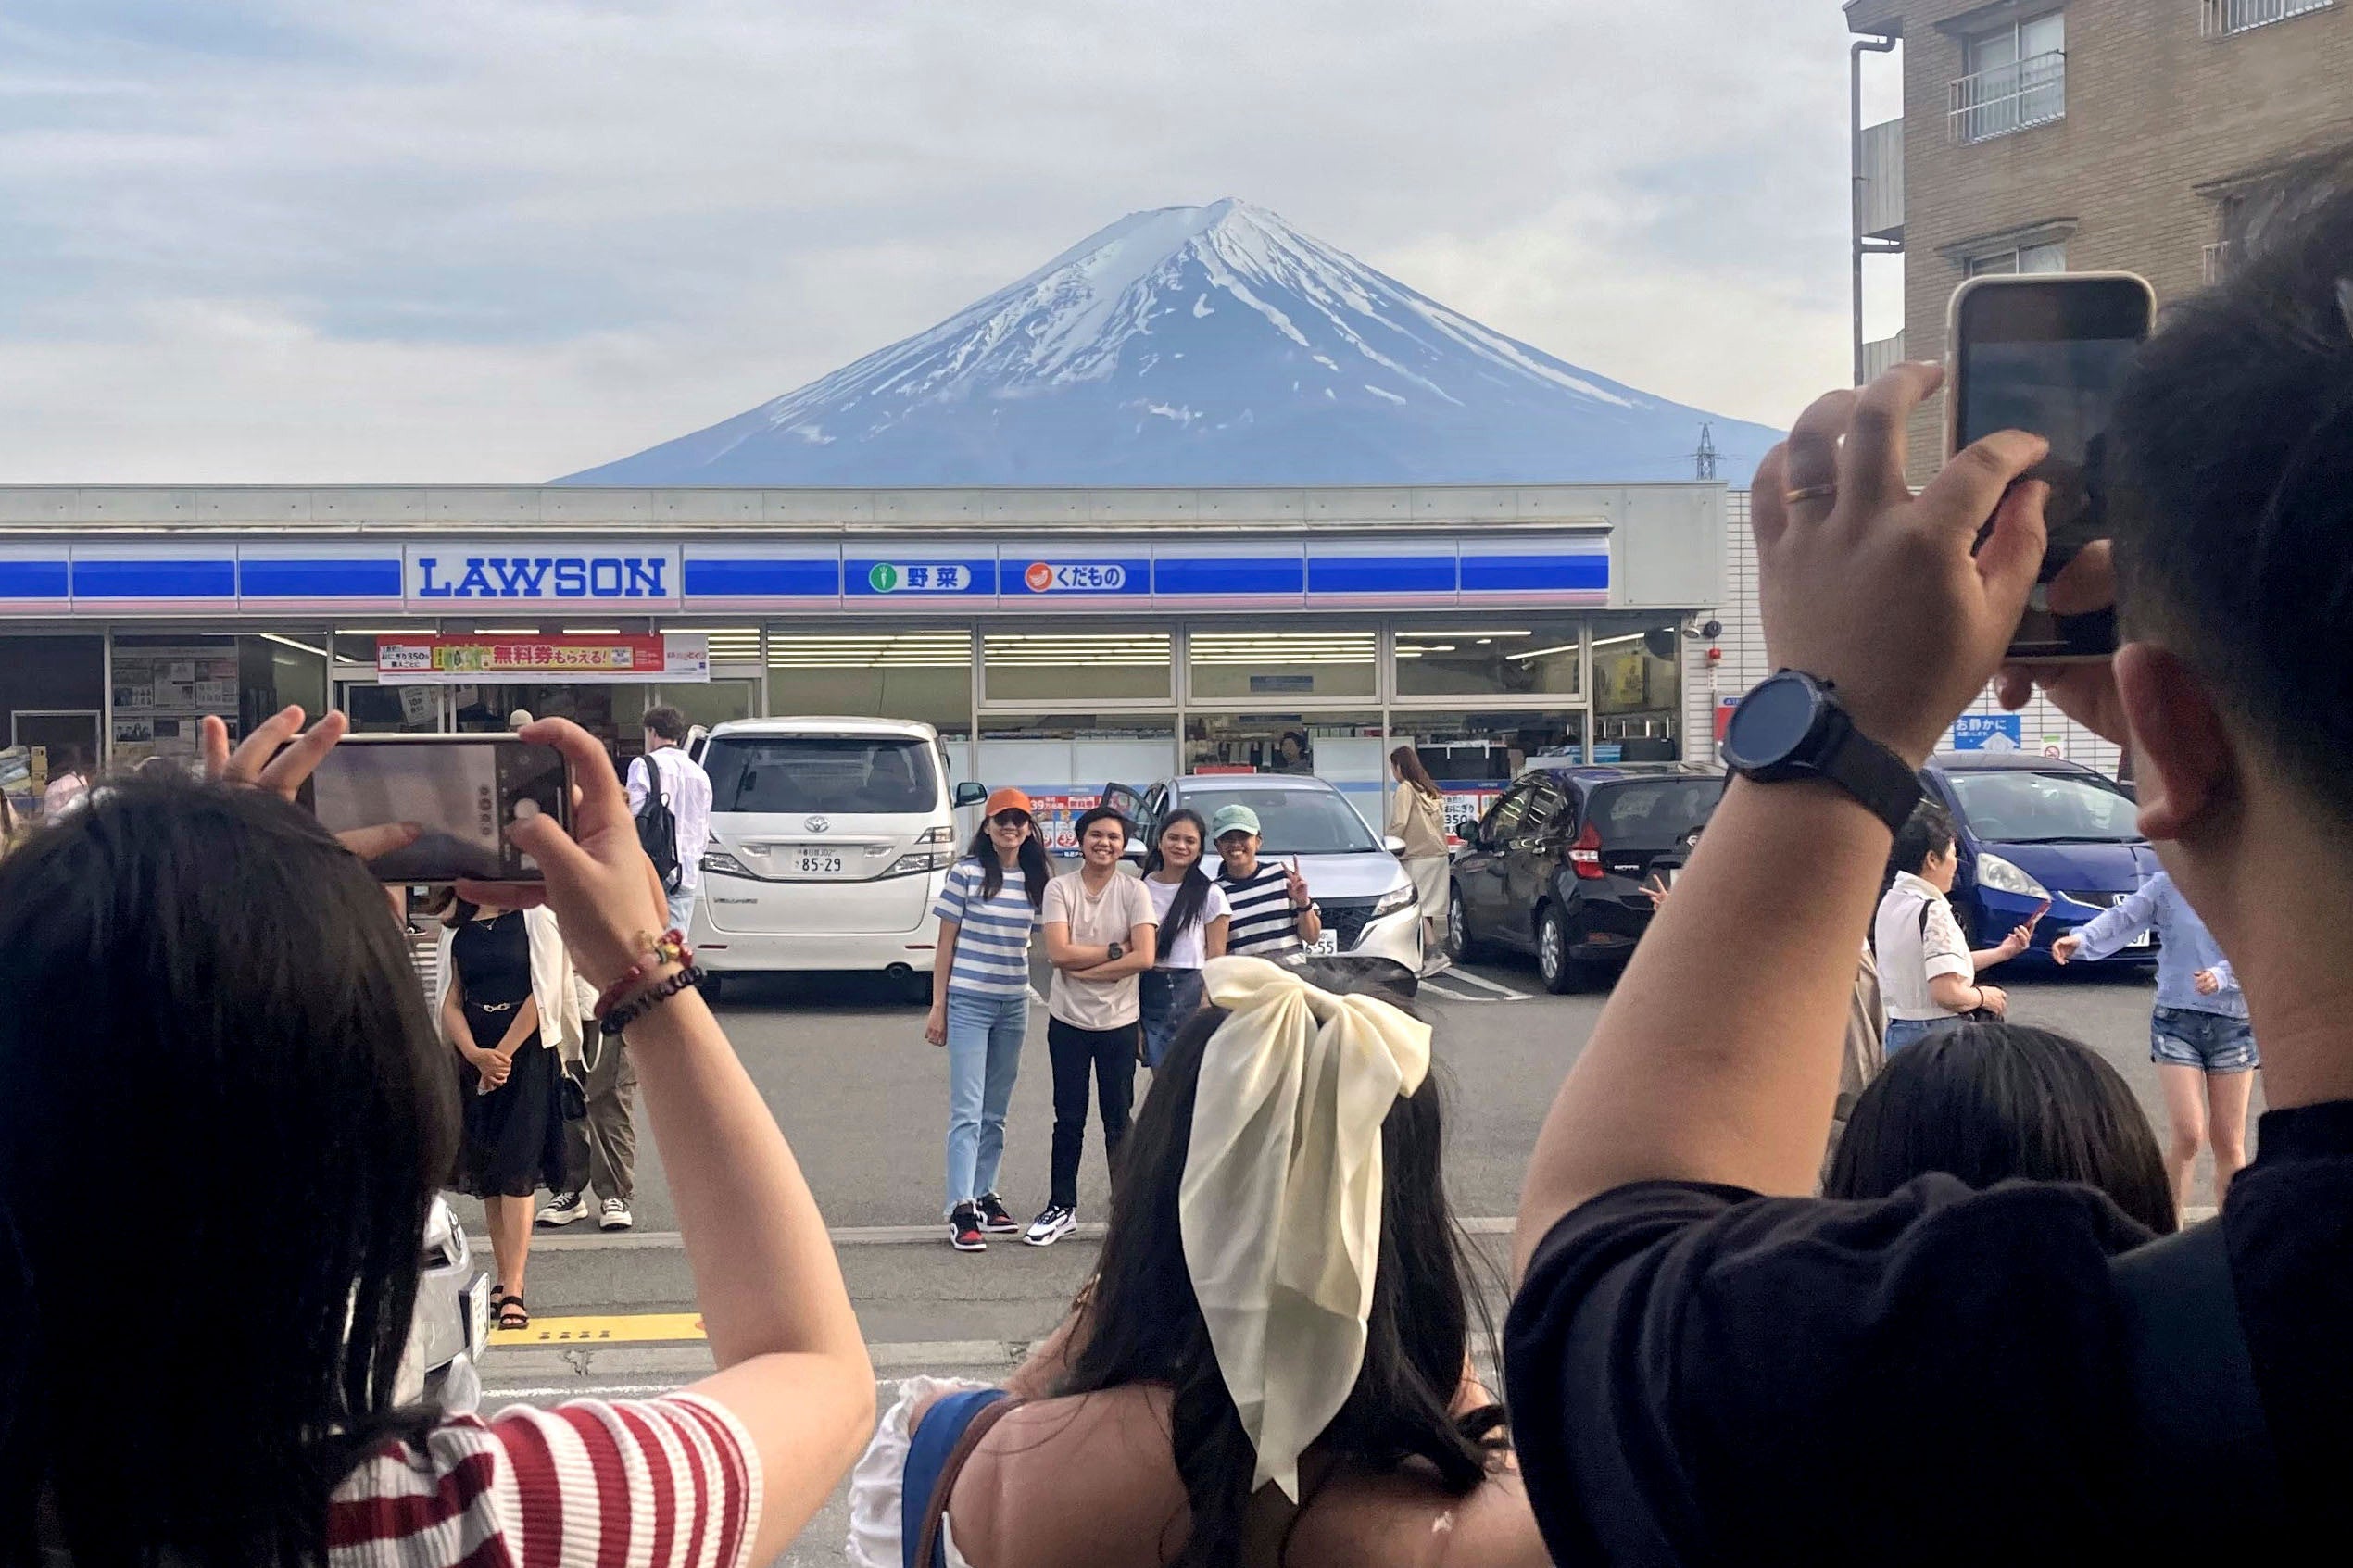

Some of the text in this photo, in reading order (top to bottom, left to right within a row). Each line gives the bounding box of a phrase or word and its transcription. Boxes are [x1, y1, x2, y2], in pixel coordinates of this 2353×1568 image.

[419, 558, 666, 596] LAWSON
[907, 567, 958, 588] 野菜
[1057, 566, 1119, 586] くだもの
[494, 646, 606, 664] 無料券もらえる!
[1956, 718, 2006, 731] お静かに
[1444, 804, 1475, 813] おにぎり
[1445, 815, 1467, 824] 350
[802, 858, 841, 872] 85-29
